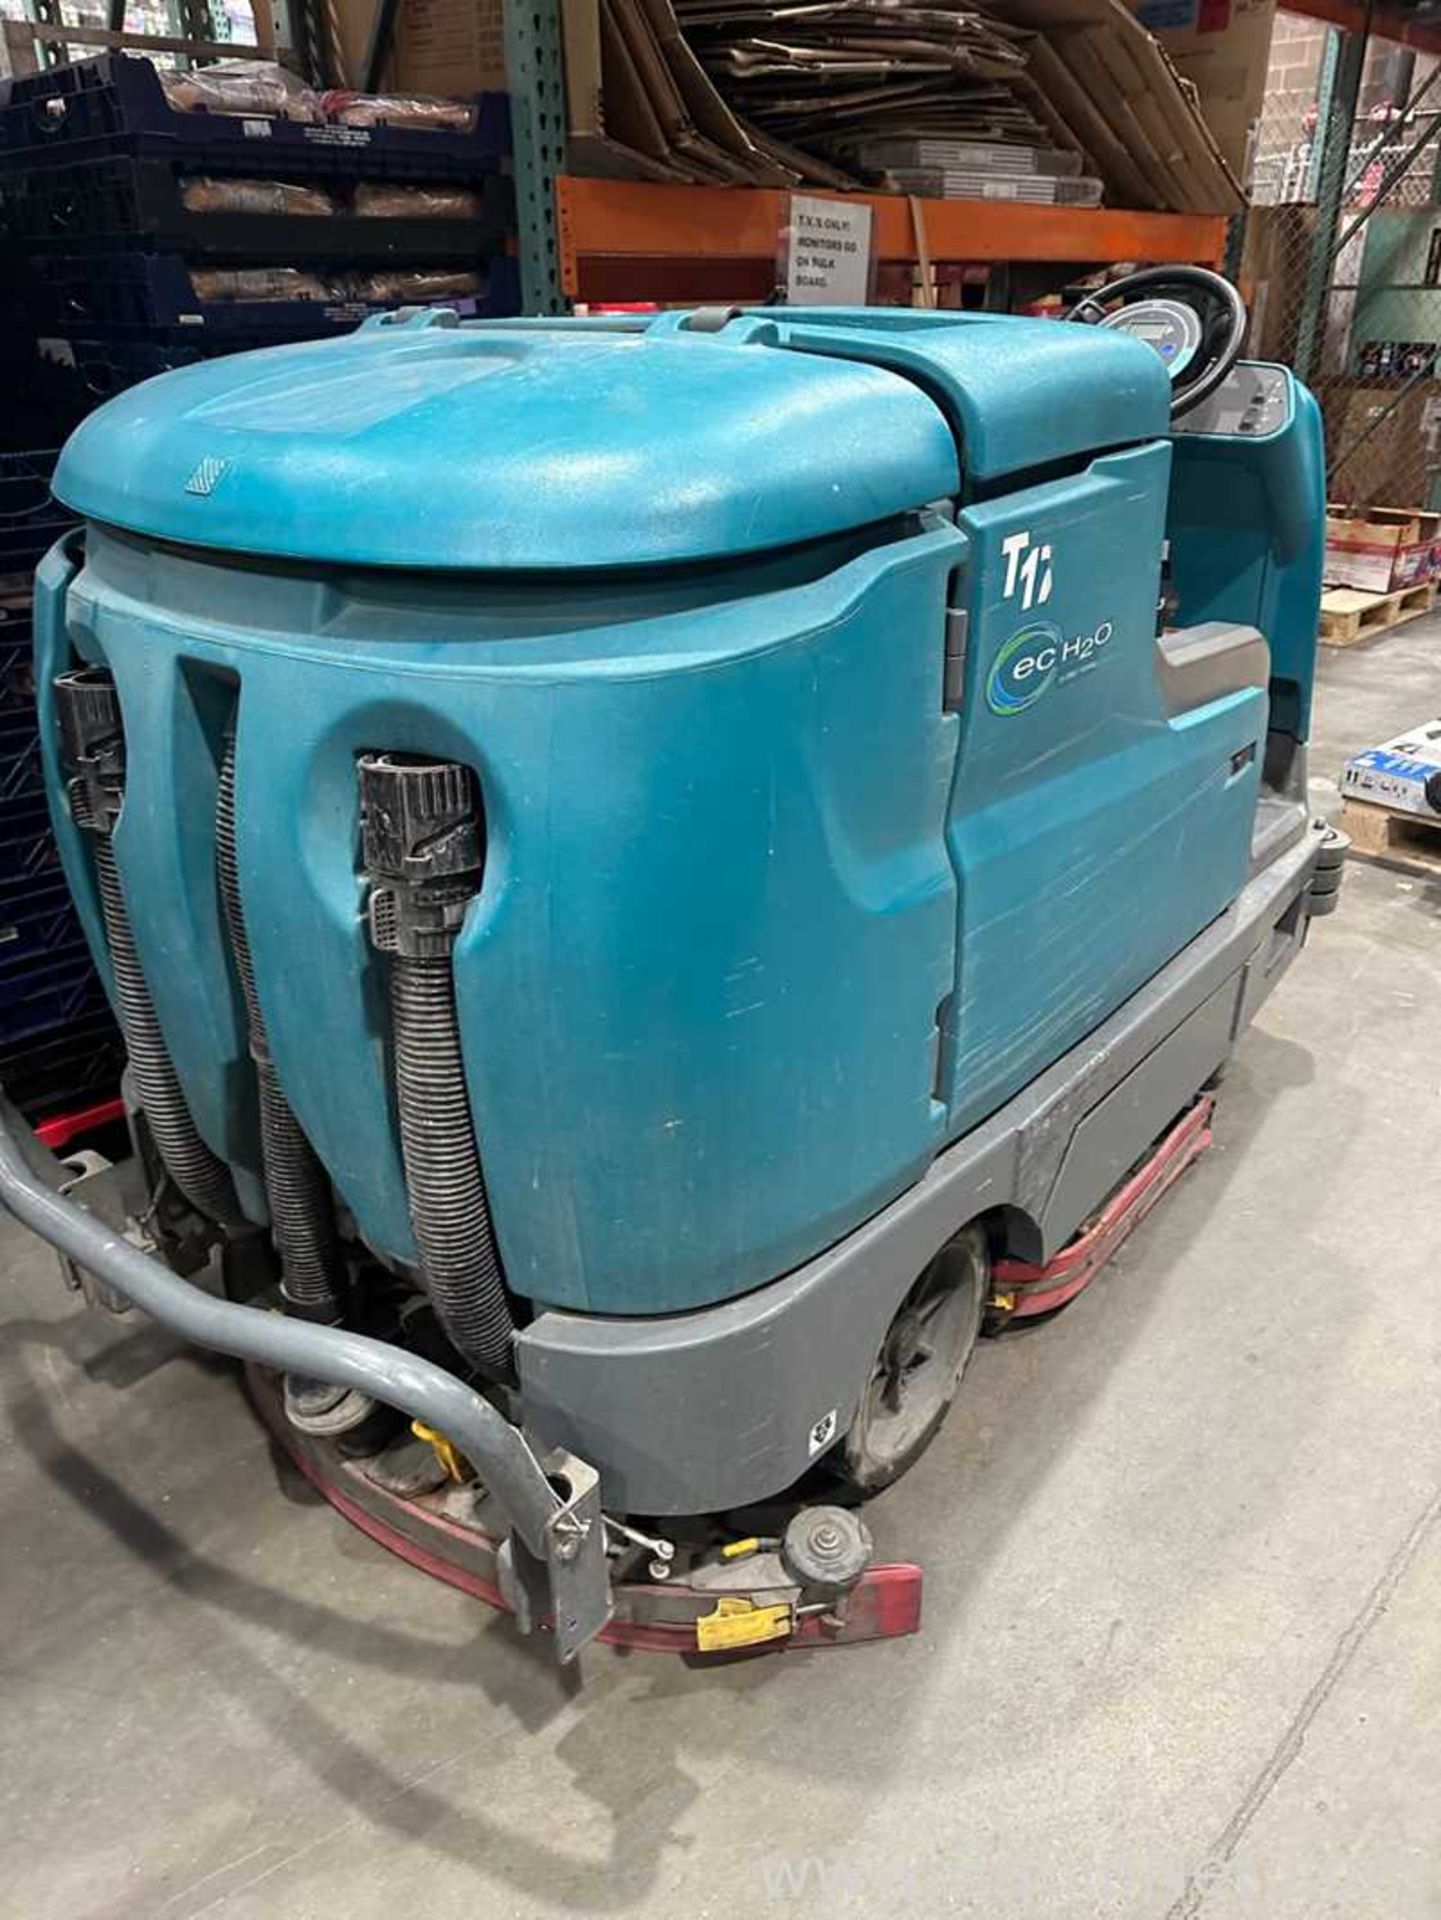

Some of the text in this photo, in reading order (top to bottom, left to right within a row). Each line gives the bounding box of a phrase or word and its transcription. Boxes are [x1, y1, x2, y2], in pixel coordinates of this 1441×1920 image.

[797, 236, 857, 253] MONITORS GO
[796, 256, 809, 267] ON
